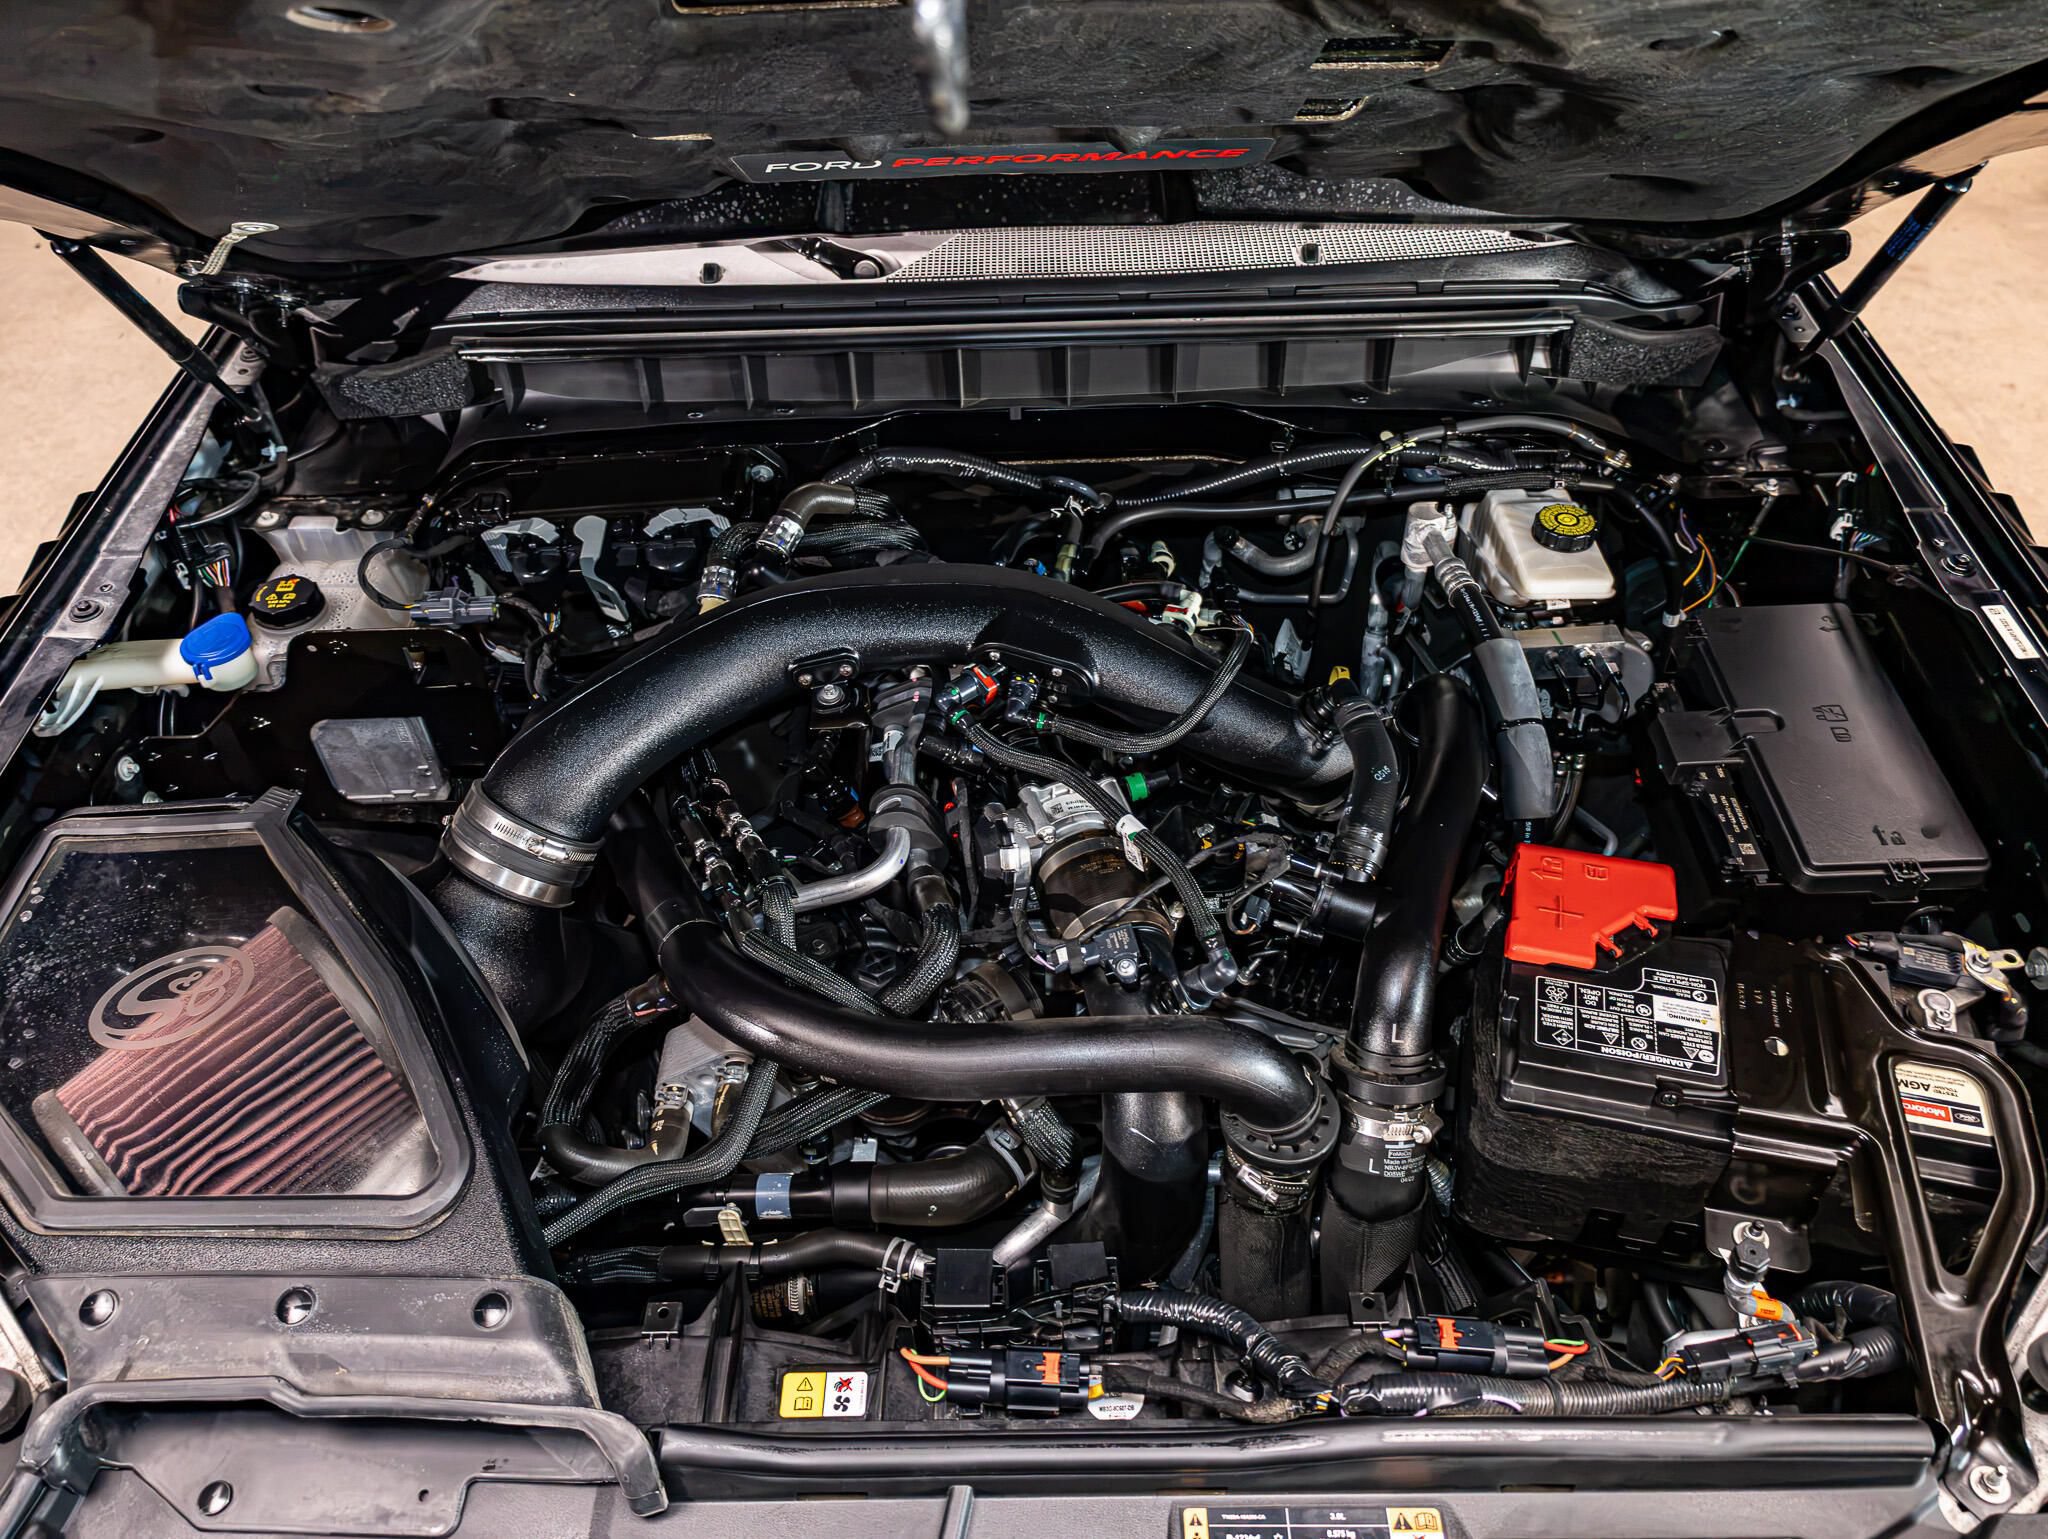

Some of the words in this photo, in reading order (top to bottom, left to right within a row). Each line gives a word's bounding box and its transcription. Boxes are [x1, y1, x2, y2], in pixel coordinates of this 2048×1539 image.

[764, 159, 882, 174] FORD
[891, 147, 1251, 168] PERFORMANCE
[1583, 994, 1599, 1002] NOT
[1391, 1023, 1405, 1044] L
[1600, 1046, 1685, 1068] DANGER/POISON
[1897, 1078, 1931, 1092] AGM
[1902, 1102, 1946, 1117] Motorc
[1368, 1158, 1381, 1175] L
